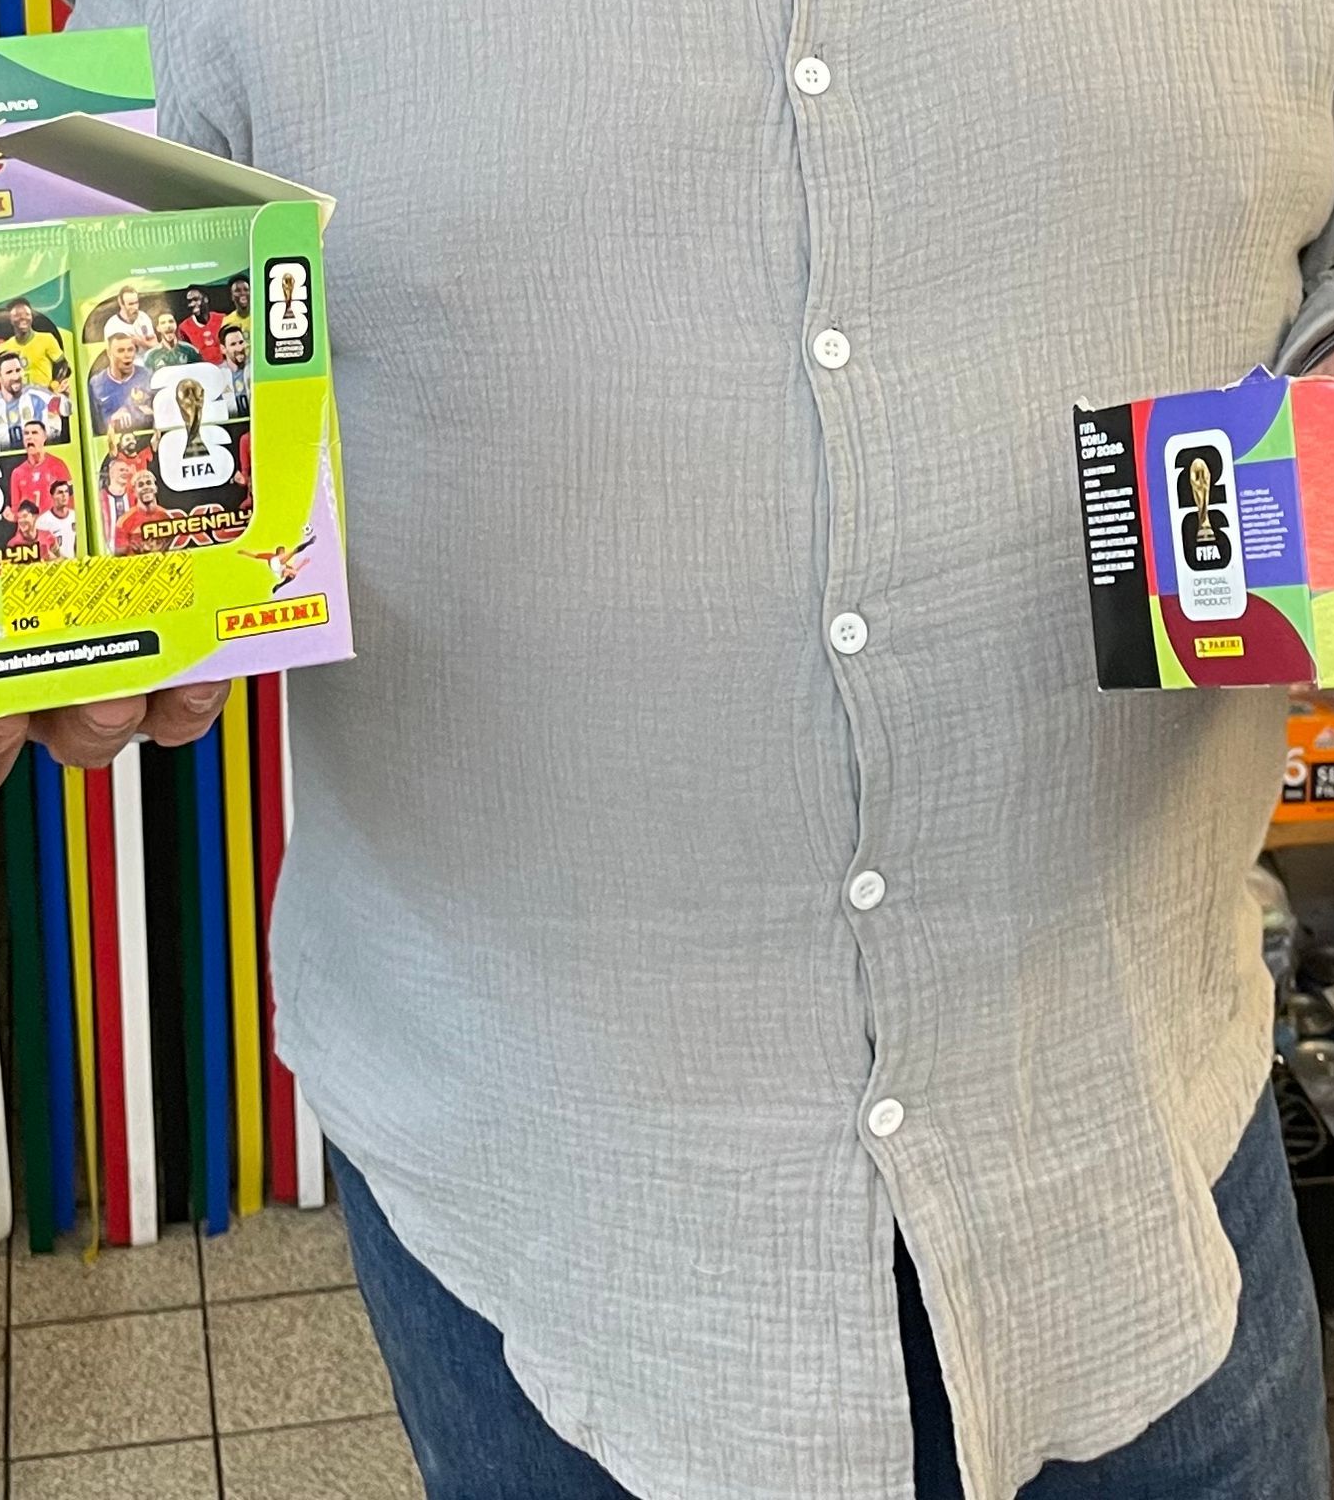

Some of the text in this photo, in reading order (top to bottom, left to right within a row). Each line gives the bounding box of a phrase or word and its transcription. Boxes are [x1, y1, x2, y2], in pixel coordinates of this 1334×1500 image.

[182, 462, 215, 479] FIFA
[1196, 546, 1220, 561] FIFA
[1193, 576, 1228, 586] OFFICIAL
[1193, 586, 1232, 596] LICENSED
[1194, 596, 1231, 606] PRODUCT
[10, 615, 40, 631] 106
[225, 601, 322, 631] PANINI
